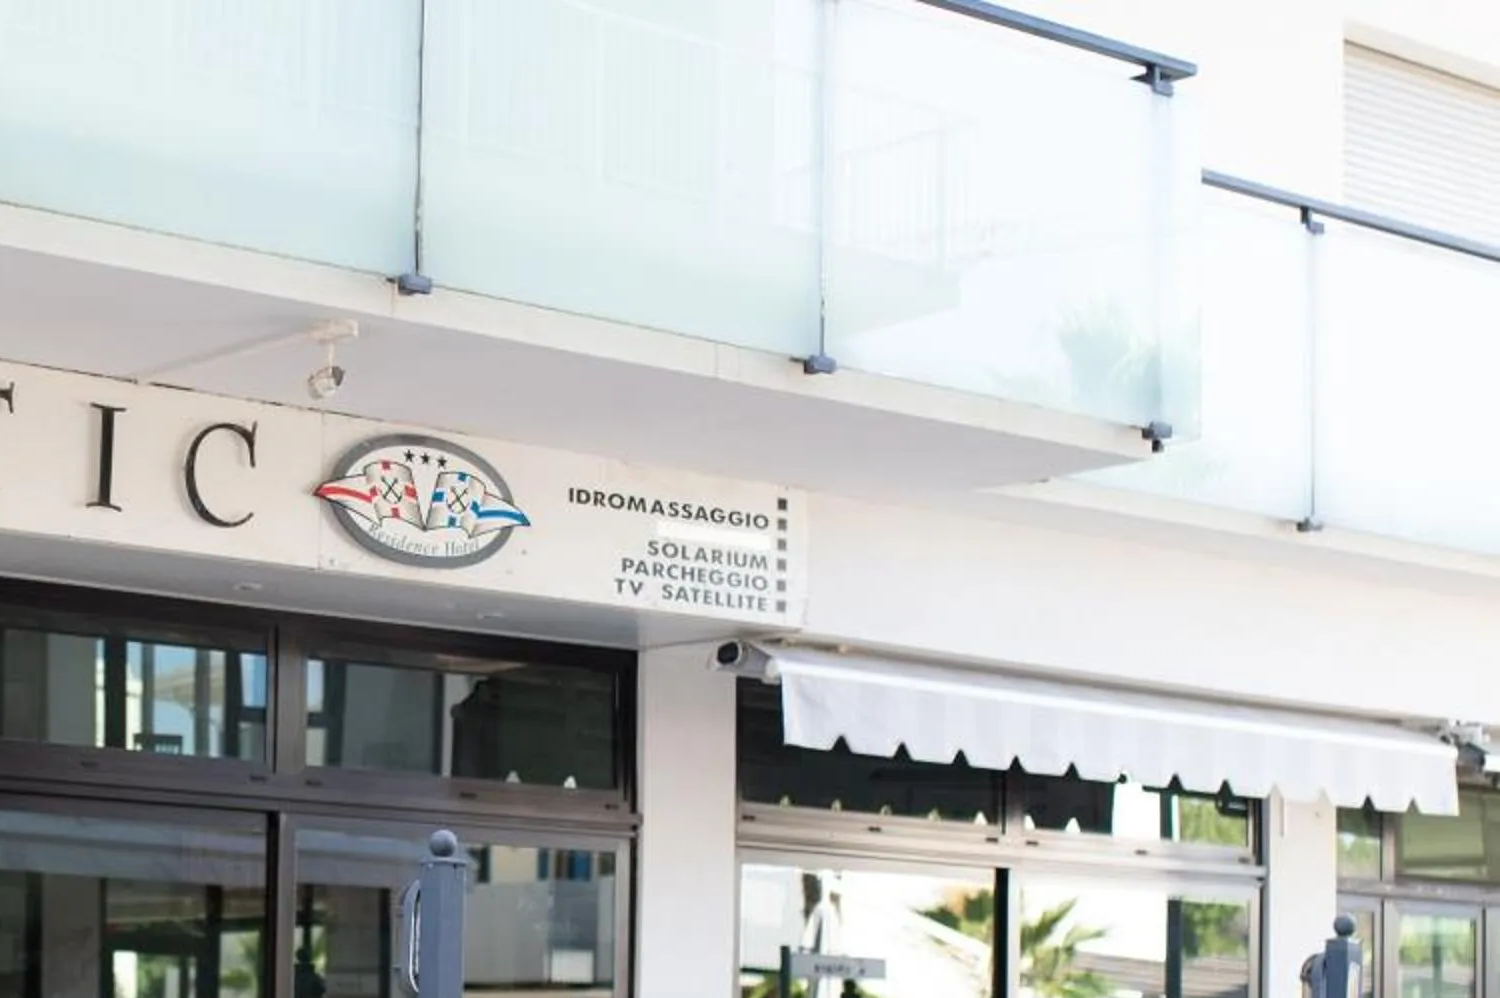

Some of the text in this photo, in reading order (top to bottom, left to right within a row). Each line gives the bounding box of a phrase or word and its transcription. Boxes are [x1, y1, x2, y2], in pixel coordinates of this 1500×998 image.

[567, 487, 770, 530] IDROMASSAGGIO
[647, 540, 769, 572] SOLARIUM
[621, 557, 768, 592] PARCHEGGIO
[614, 578, 768, 612] TV SATELLITE
